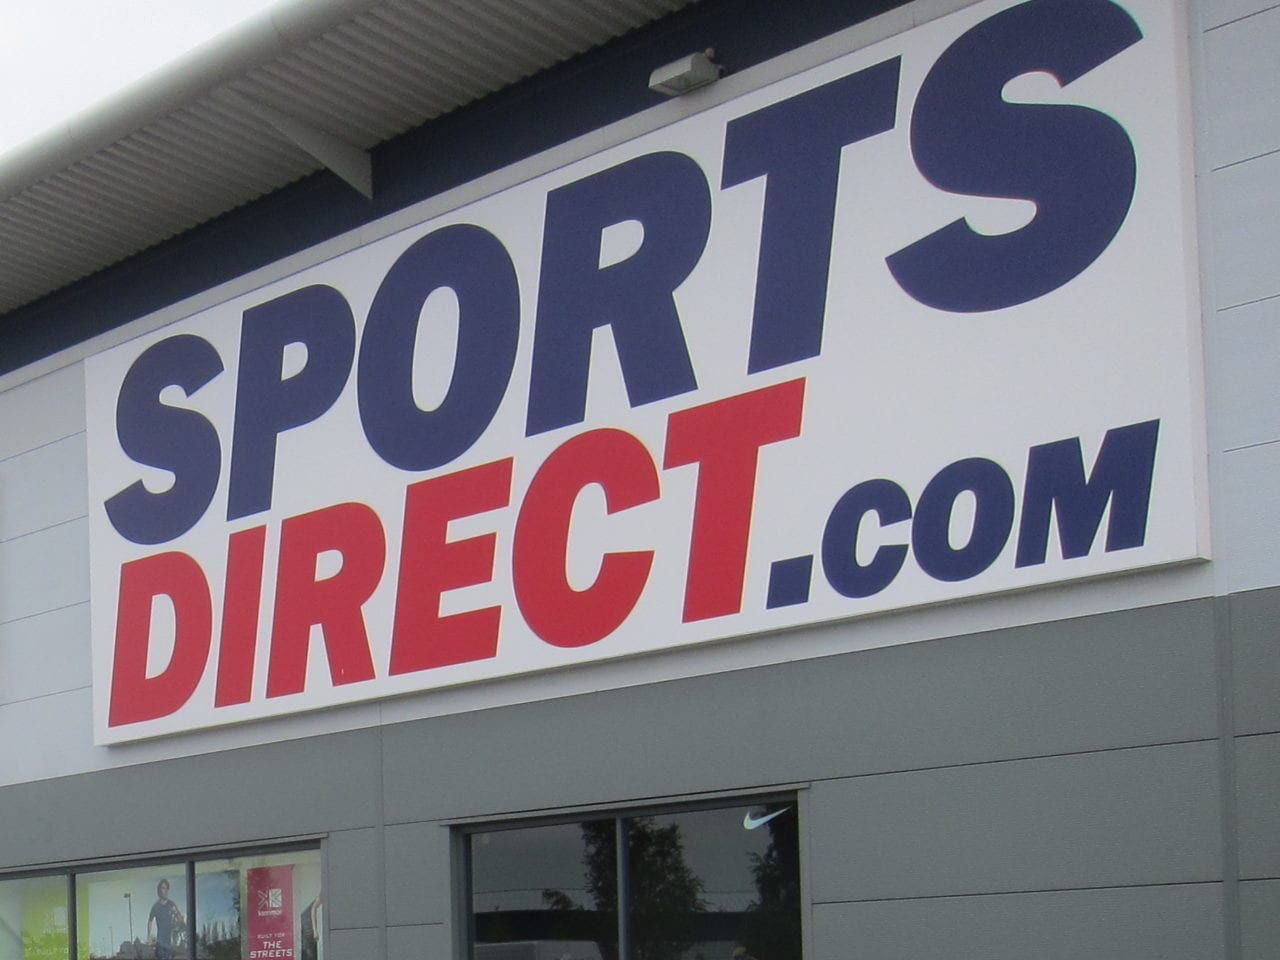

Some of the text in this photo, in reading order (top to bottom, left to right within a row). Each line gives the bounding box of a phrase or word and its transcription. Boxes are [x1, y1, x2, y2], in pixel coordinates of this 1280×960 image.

[104, 0, 1144, 546] SPORTS
[263, 940, 282, 949] THE
[250, 948, 292, 959] STREETS
